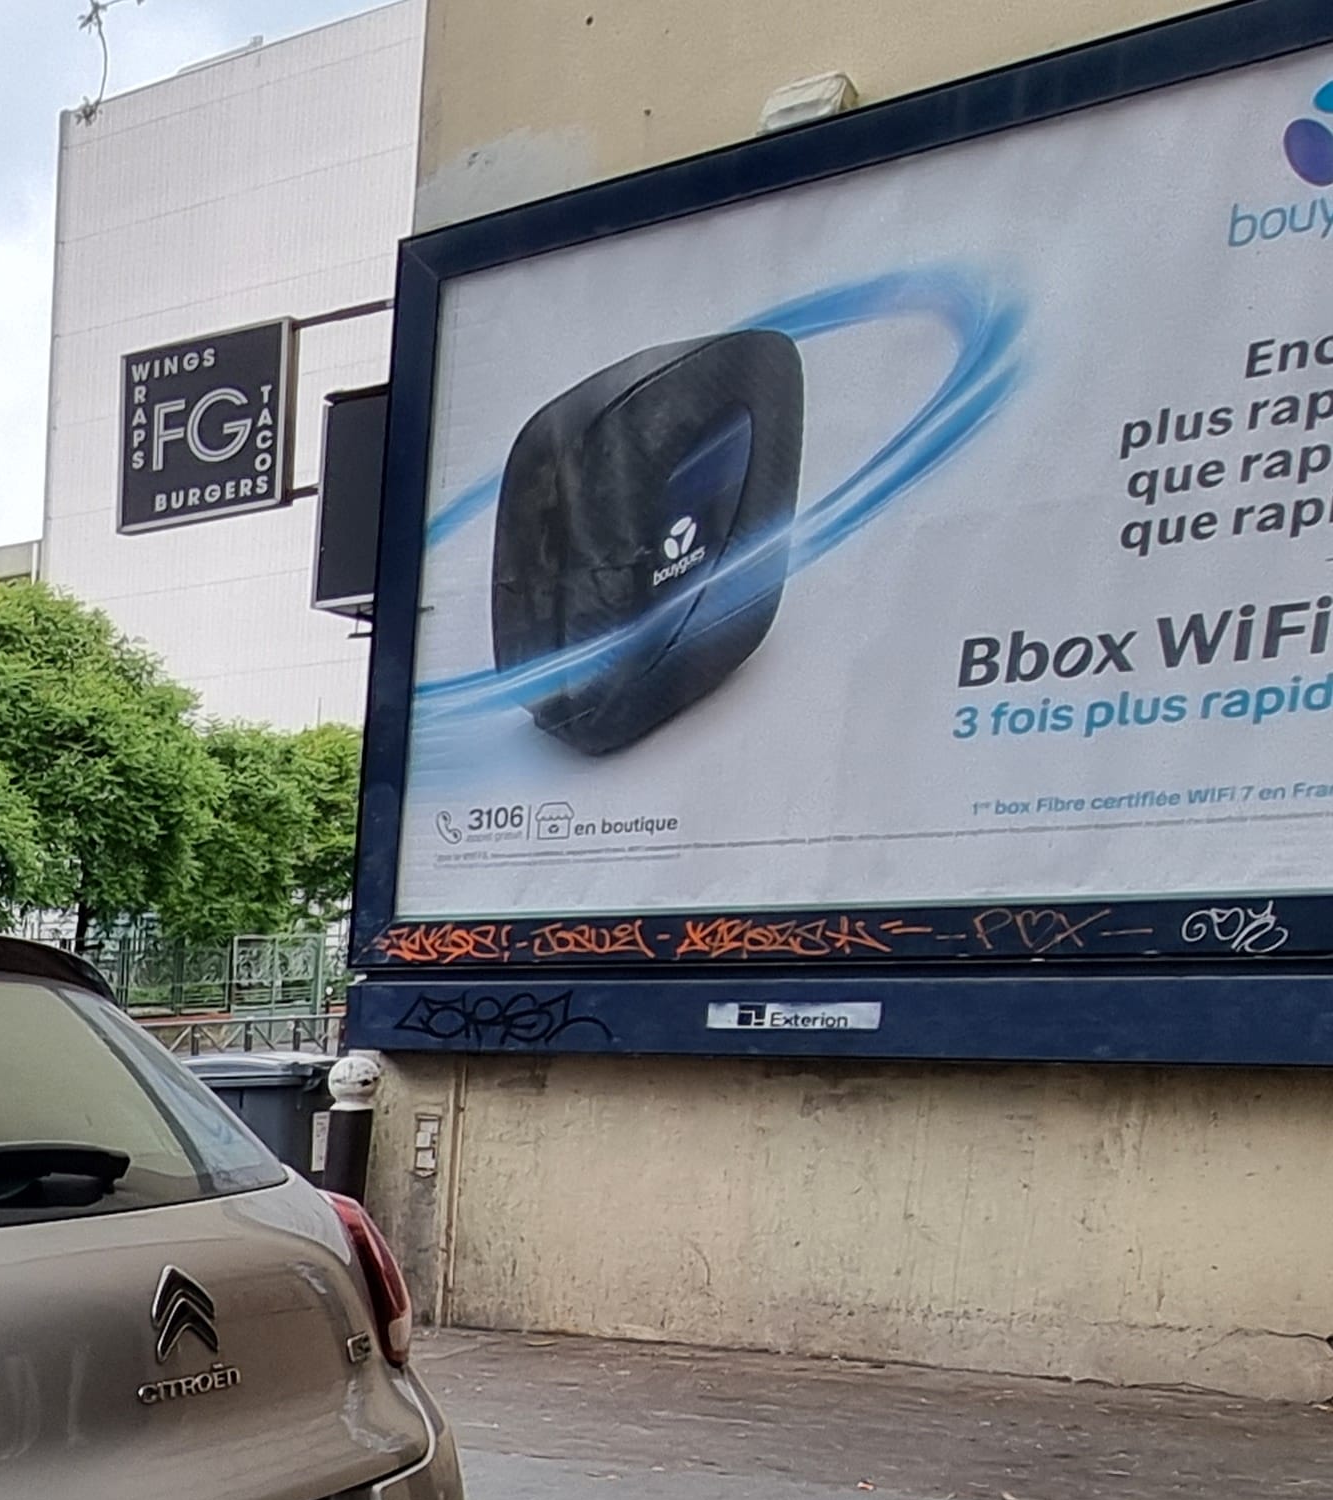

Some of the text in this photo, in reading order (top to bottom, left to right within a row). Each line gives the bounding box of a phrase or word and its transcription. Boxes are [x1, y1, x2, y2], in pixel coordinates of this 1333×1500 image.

[132, 348, 215, 382] WINGS
[152, 386, 253, 472] FG
[1120, 406, 1234, 460] plus
[154, 476, 269, 511] BURGERS
[1127, 443, 1332, 506] que rap
[1120, 511, 1218, 557] que
[958, 595, 1333, 689] Bbox WiFi
[952, 672, 1333, 740] 3 fois plus rapid
[467, 805, 524, 831] 3106
[994, 799, 1031, 815] box
[1036, 796, 1086, 813] Fibre
[1090, 790, 1181, 811] certifiée
[1241, 785, 1255, 801] 7
[1258, 786, 1286, 802] en
[574, 815, 679, 836] en boutique
[770, 1012, 849, 1028] Exterion
